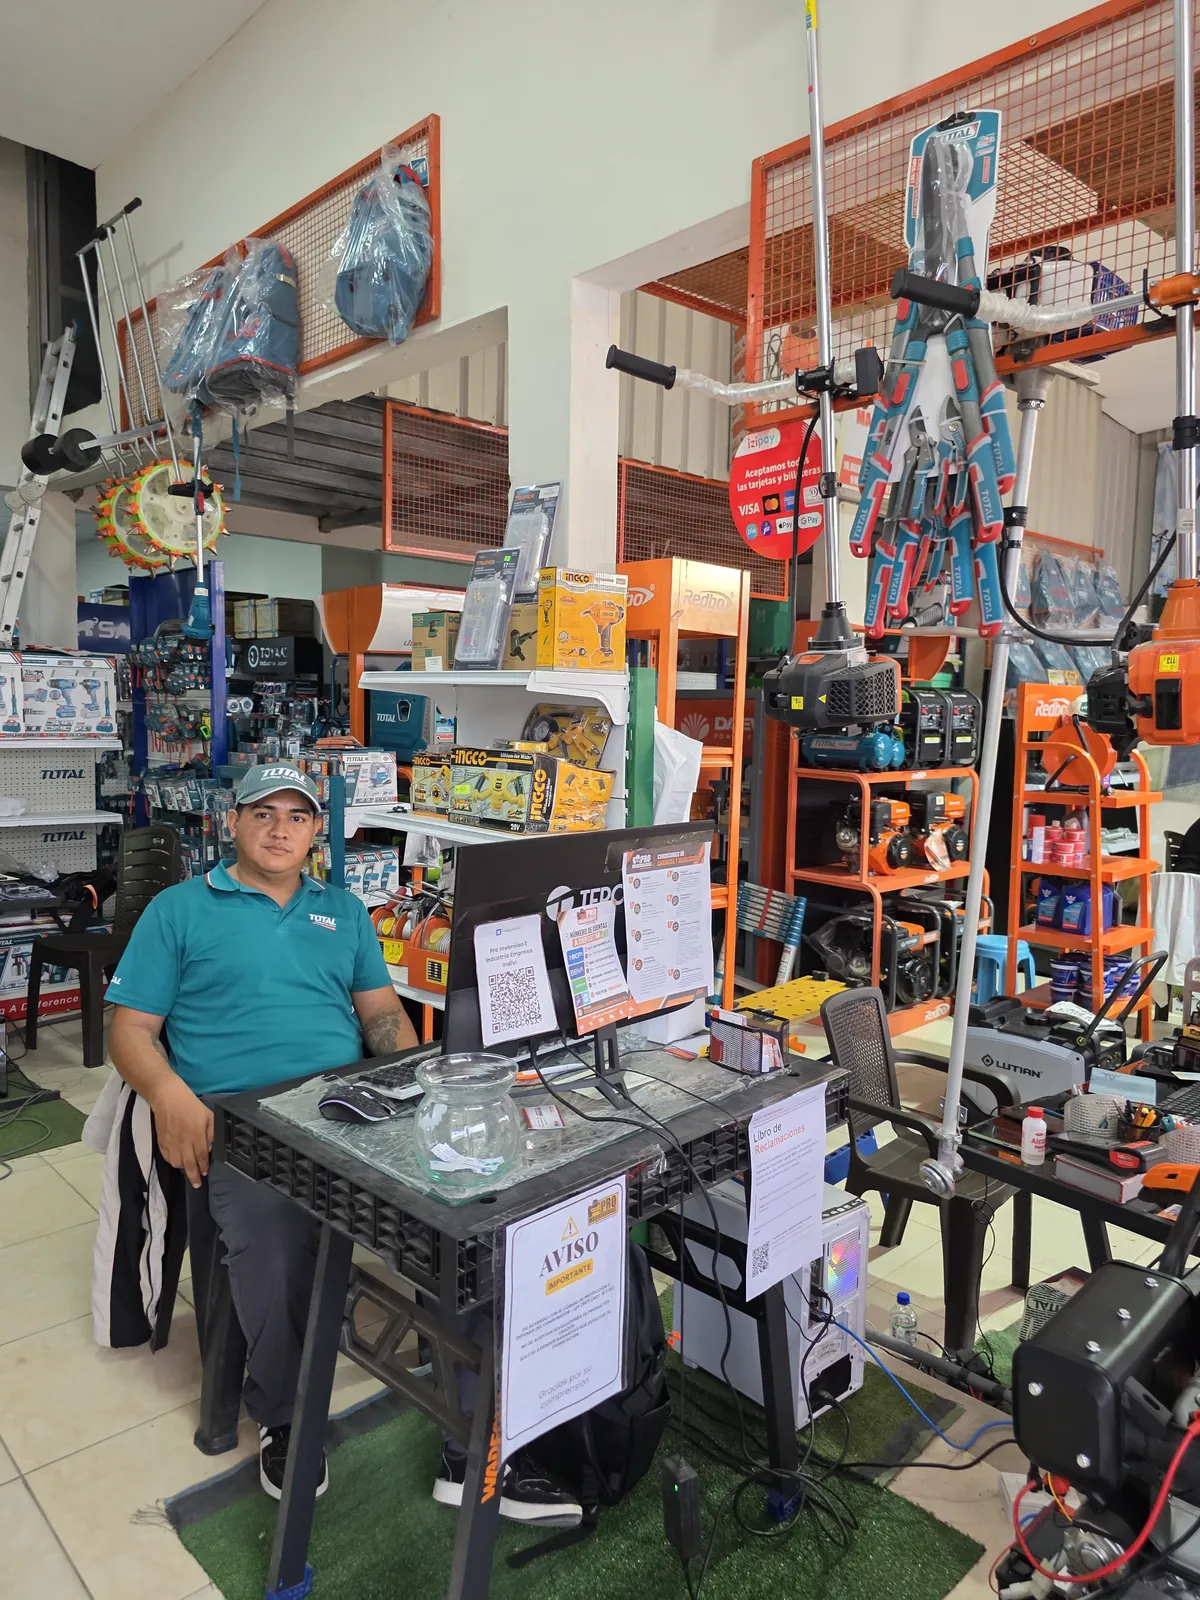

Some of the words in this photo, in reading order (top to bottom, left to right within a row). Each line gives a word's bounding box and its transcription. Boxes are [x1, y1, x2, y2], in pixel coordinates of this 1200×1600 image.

[747, 434, 775, 449] izipay
[745, 461, 786, 479] Aceptamos
[787, 456, 810, 468] tods
[862, 450, 874, 482] TOTAL
[992, 441, 1005, 474] TOTAL
[737, 483, 747, 492] las
[748, 476, 776, 490] tarjetas
[777, 475, 782, 484] y
[738, 502, 760, 516] VISA
[981, 489, 994, 521] TOTAL
[782, 521, 792, 529] Pay
[807, 516, 819, 525] Pay
[853, 508, 868, 538] TOTAL
[889, 571, 901, 601] TOTAL
[954, 565, 963, 596] TOTAL
[683, 588, 732, 609] Redbo
[867, 593, 877, 621] TOTAL
[983, 588, 993, 619] TOTAL
[376, 713, 396, 722] TOTAL
[41, 769, 85, 779] TOTAL
[262, 767, 306, 783] TOTAL
[42, 830, 86, 842] TOTAL
[309, 913, 336, 925] TOTAL
[9, 1004, 16, 1012] A
[21, 995, 79, 1011] Dference
[996, 1060, 1041, 1079] LUTIAN
[753, 1128, 771, 1143] Libro
[773, 1123, 782, 1133] de
[754, 1124, 806, 1155] Reclamaciones
[601, 1195, 617, 1211] PRO
[540, 1231, 599, 1278] AVISO
[548, 1263, 592, 1290] IMPORTANTE
[538, 1378, 568, 1399] Gracias
[569, 1370, 582, 1385] por
[583, 1364, 592, 1375] su
